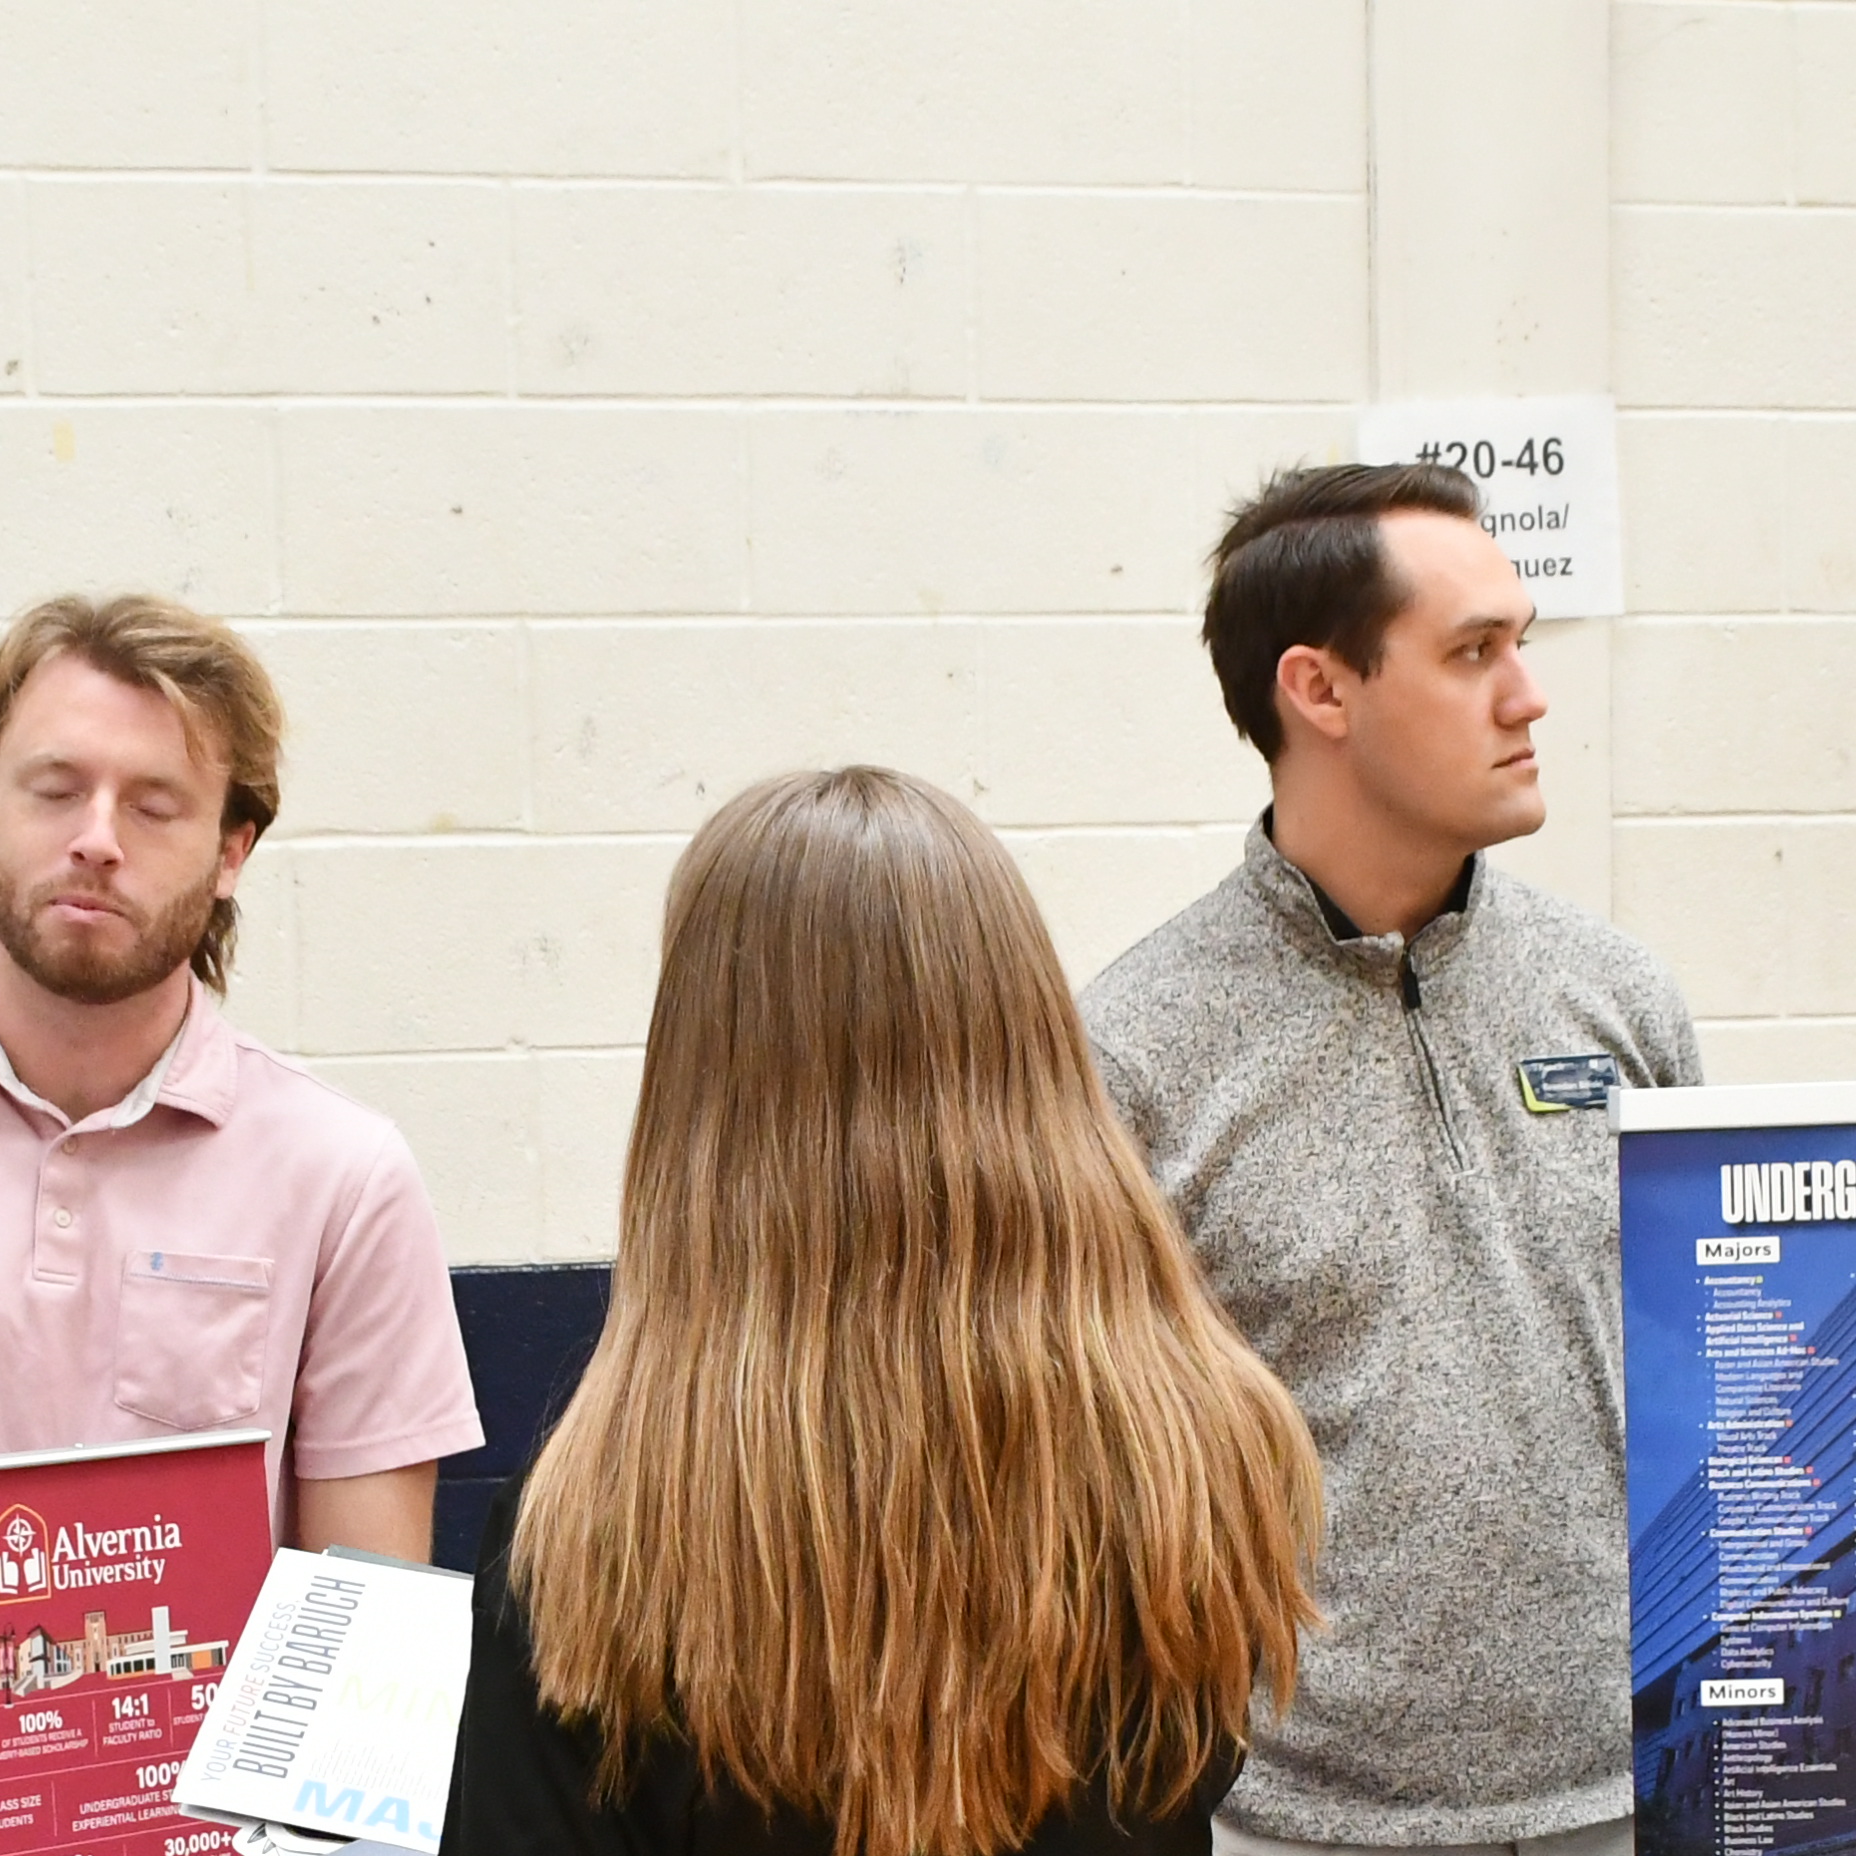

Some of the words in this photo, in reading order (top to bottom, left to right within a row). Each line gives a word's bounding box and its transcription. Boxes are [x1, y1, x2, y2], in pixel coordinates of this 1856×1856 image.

[1416, 437, 1564, 478] #20-46
[1705, 1242, 1772, 1261] Majors
[51, 1513, 183, 1563] Alvernia
[52, 1553, 167, 1591] University
[278, 1575, 366, 1675] BARUCH
[112, 1693, 149, 1719] 14:1
[262, 1674, 324, 1711] BY
[1709, 1684, 1776, 1699] Minors
[19, 1710, 63, 1734] 100%
[103, 1733, 138, 1746] FACULTY
[139, 1729, 162, 1740] RATIO
[109, 1720, 143, 1733] STUDENT
[200, 1738, 238, 1782] YOUR
[223, 1674, 265, 1736] FUTURE
[232, 1709, 308, 1779] BUILT
[21, 1794, 42, 1808] SIZE
